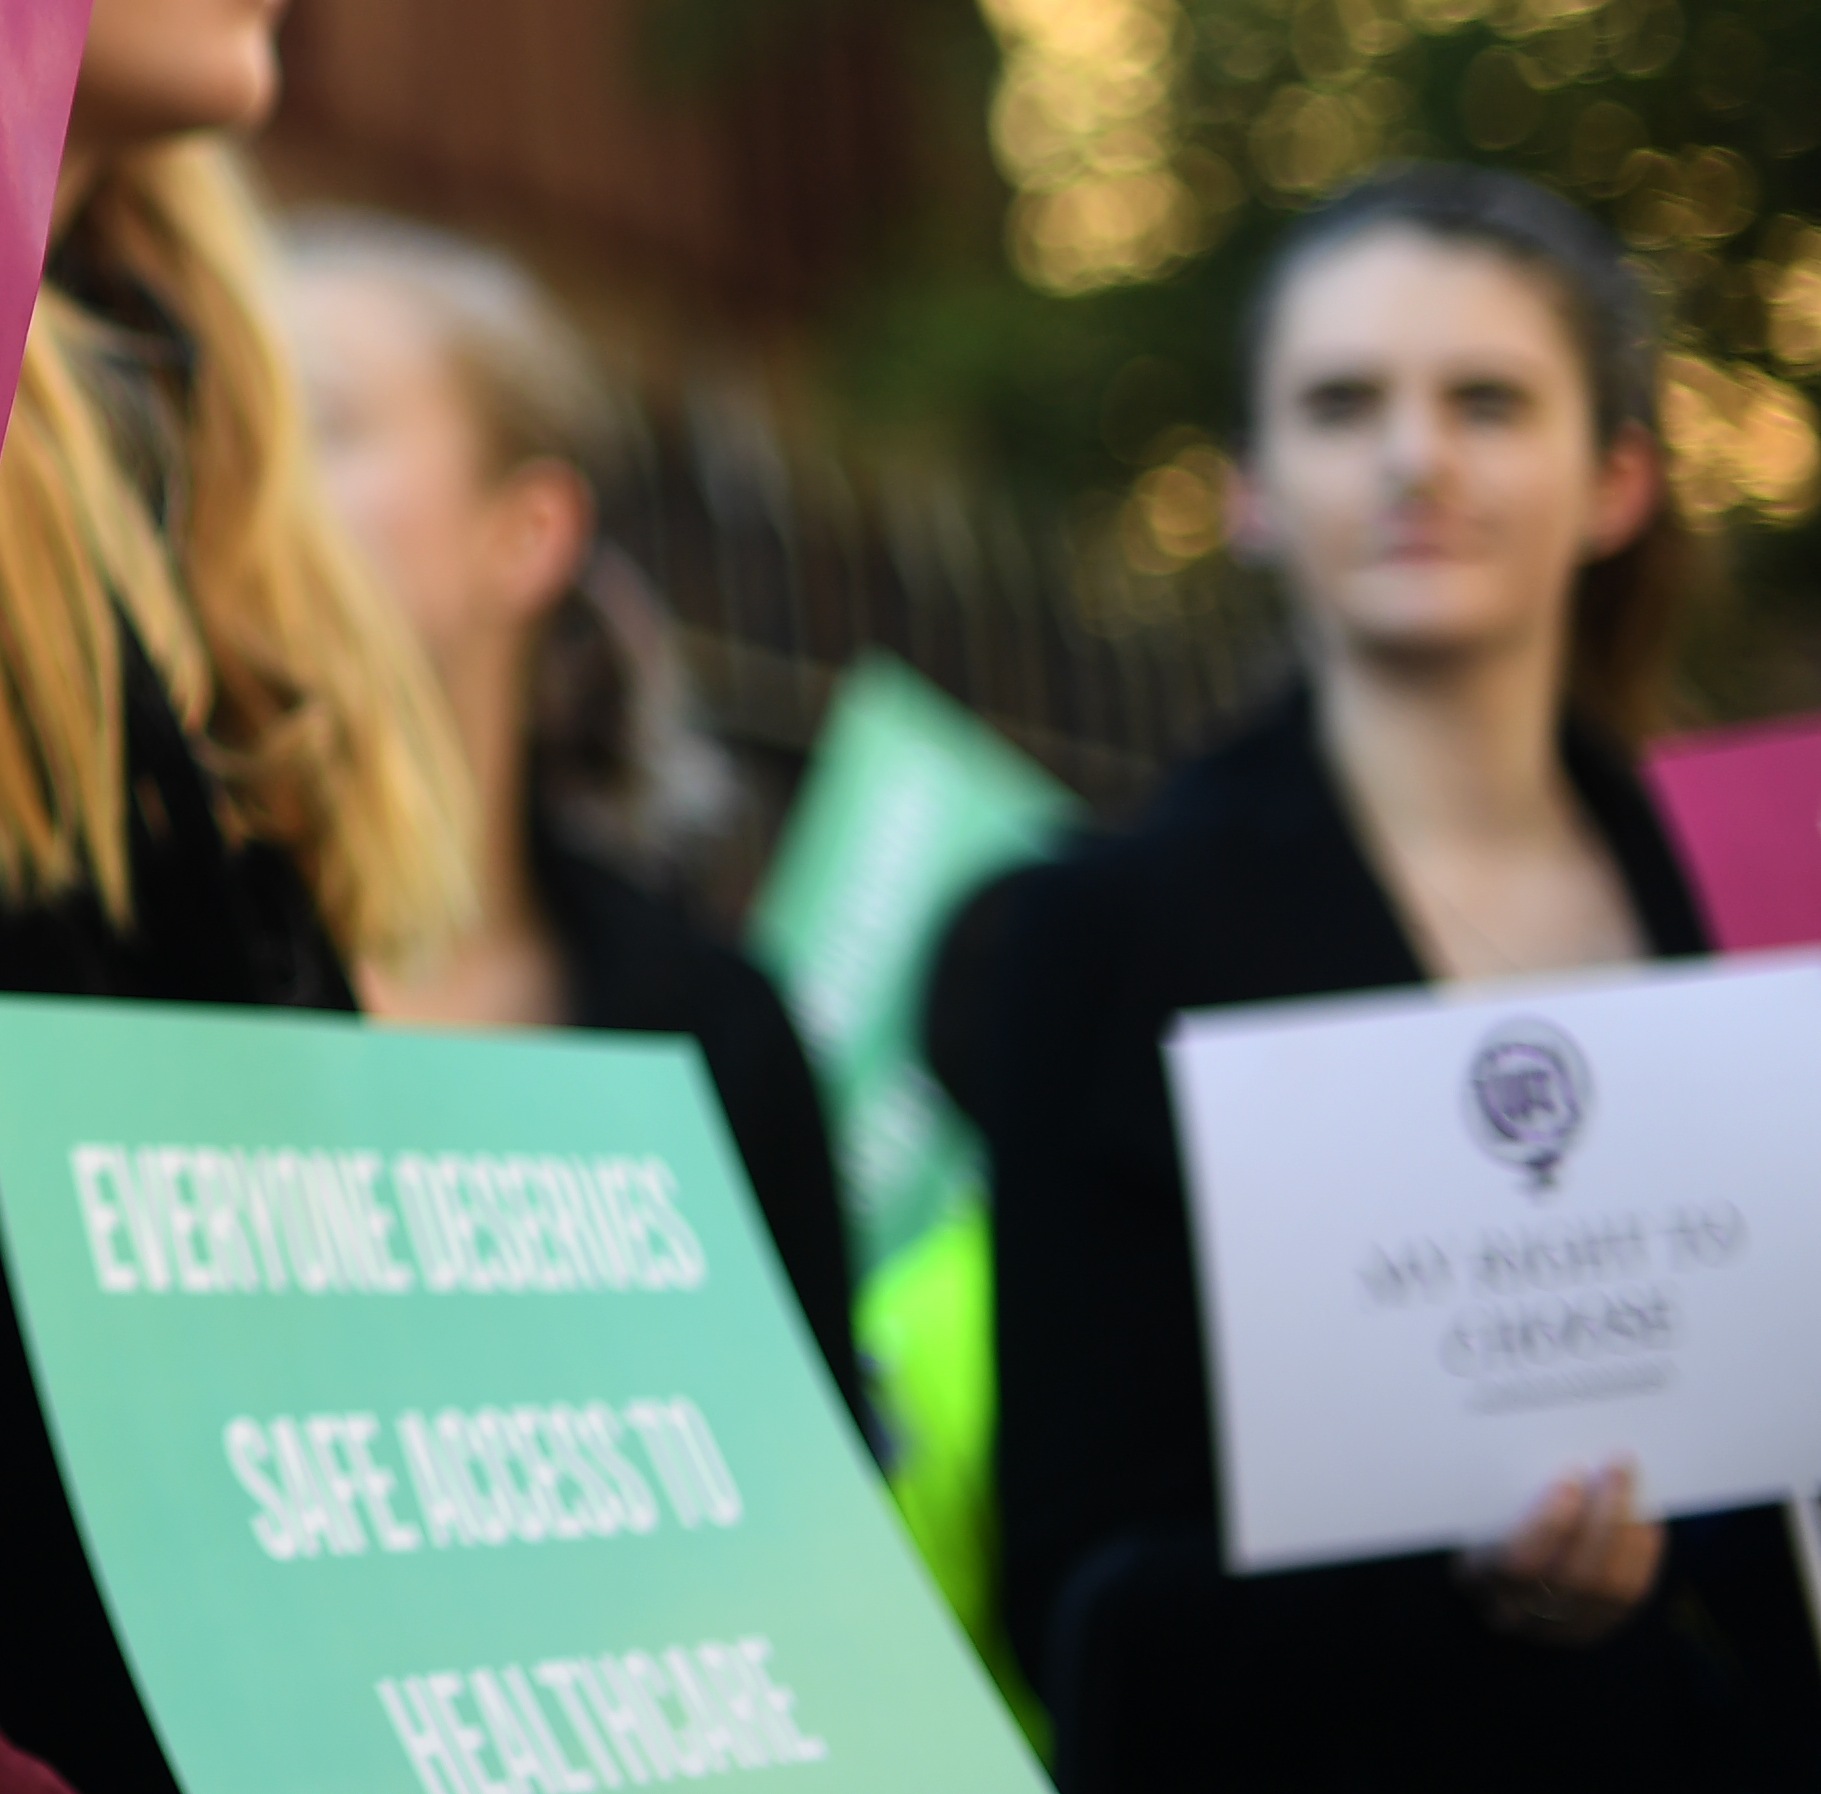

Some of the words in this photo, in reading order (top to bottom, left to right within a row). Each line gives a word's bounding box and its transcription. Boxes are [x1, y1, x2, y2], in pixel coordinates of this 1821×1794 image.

[69, 1141, 414, 1296] EVERYONE
[392, 1149, 709, 1296] DESERVES
[222, 1412, 422, 1561] SAFE
[394, 1401, 659, 1551] ACCESS
[623, 1394, 743, 1530] TO
[375, 1636, 829, 1794] HEALTHCARE
